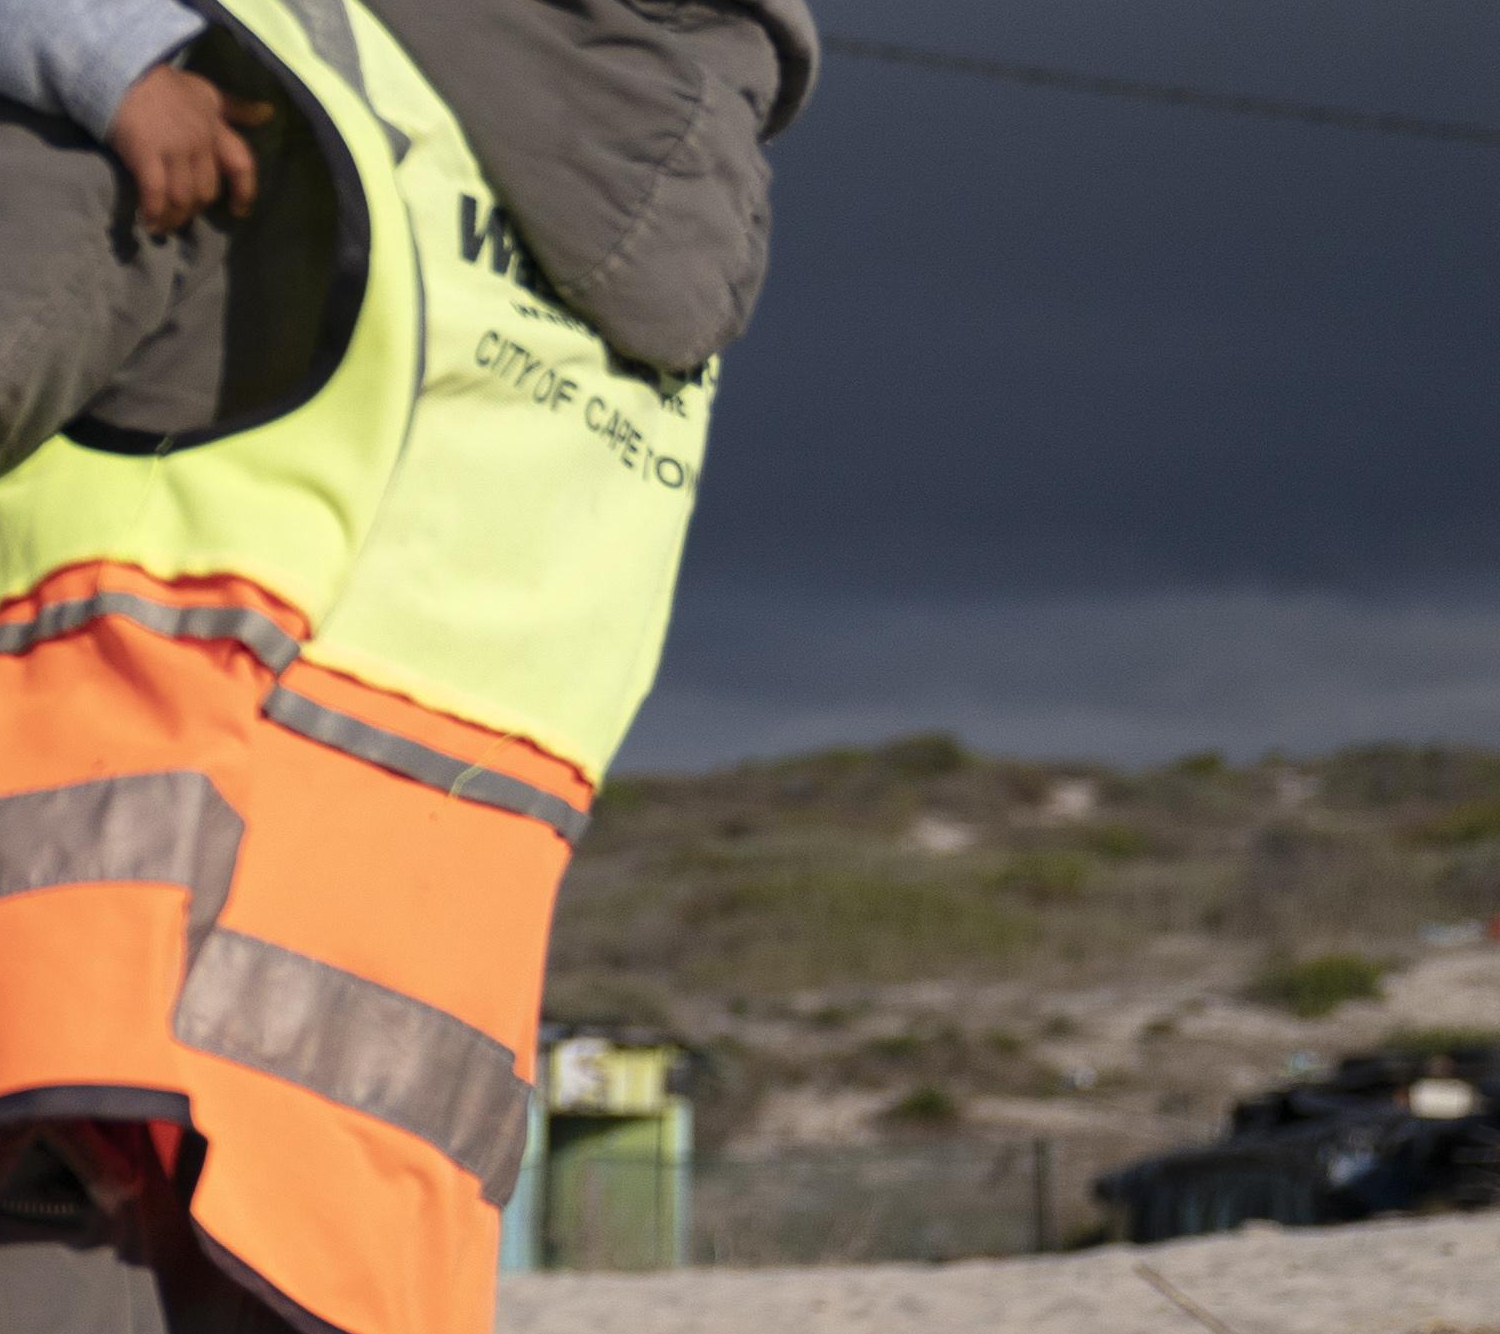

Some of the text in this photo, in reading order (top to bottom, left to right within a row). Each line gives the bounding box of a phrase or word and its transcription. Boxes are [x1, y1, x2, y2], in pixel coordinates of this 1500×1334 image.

[475, 329, 542, 388] CITY
[532, 367, 579, 412] OF
[584, 394, 643, 471] CAPE
